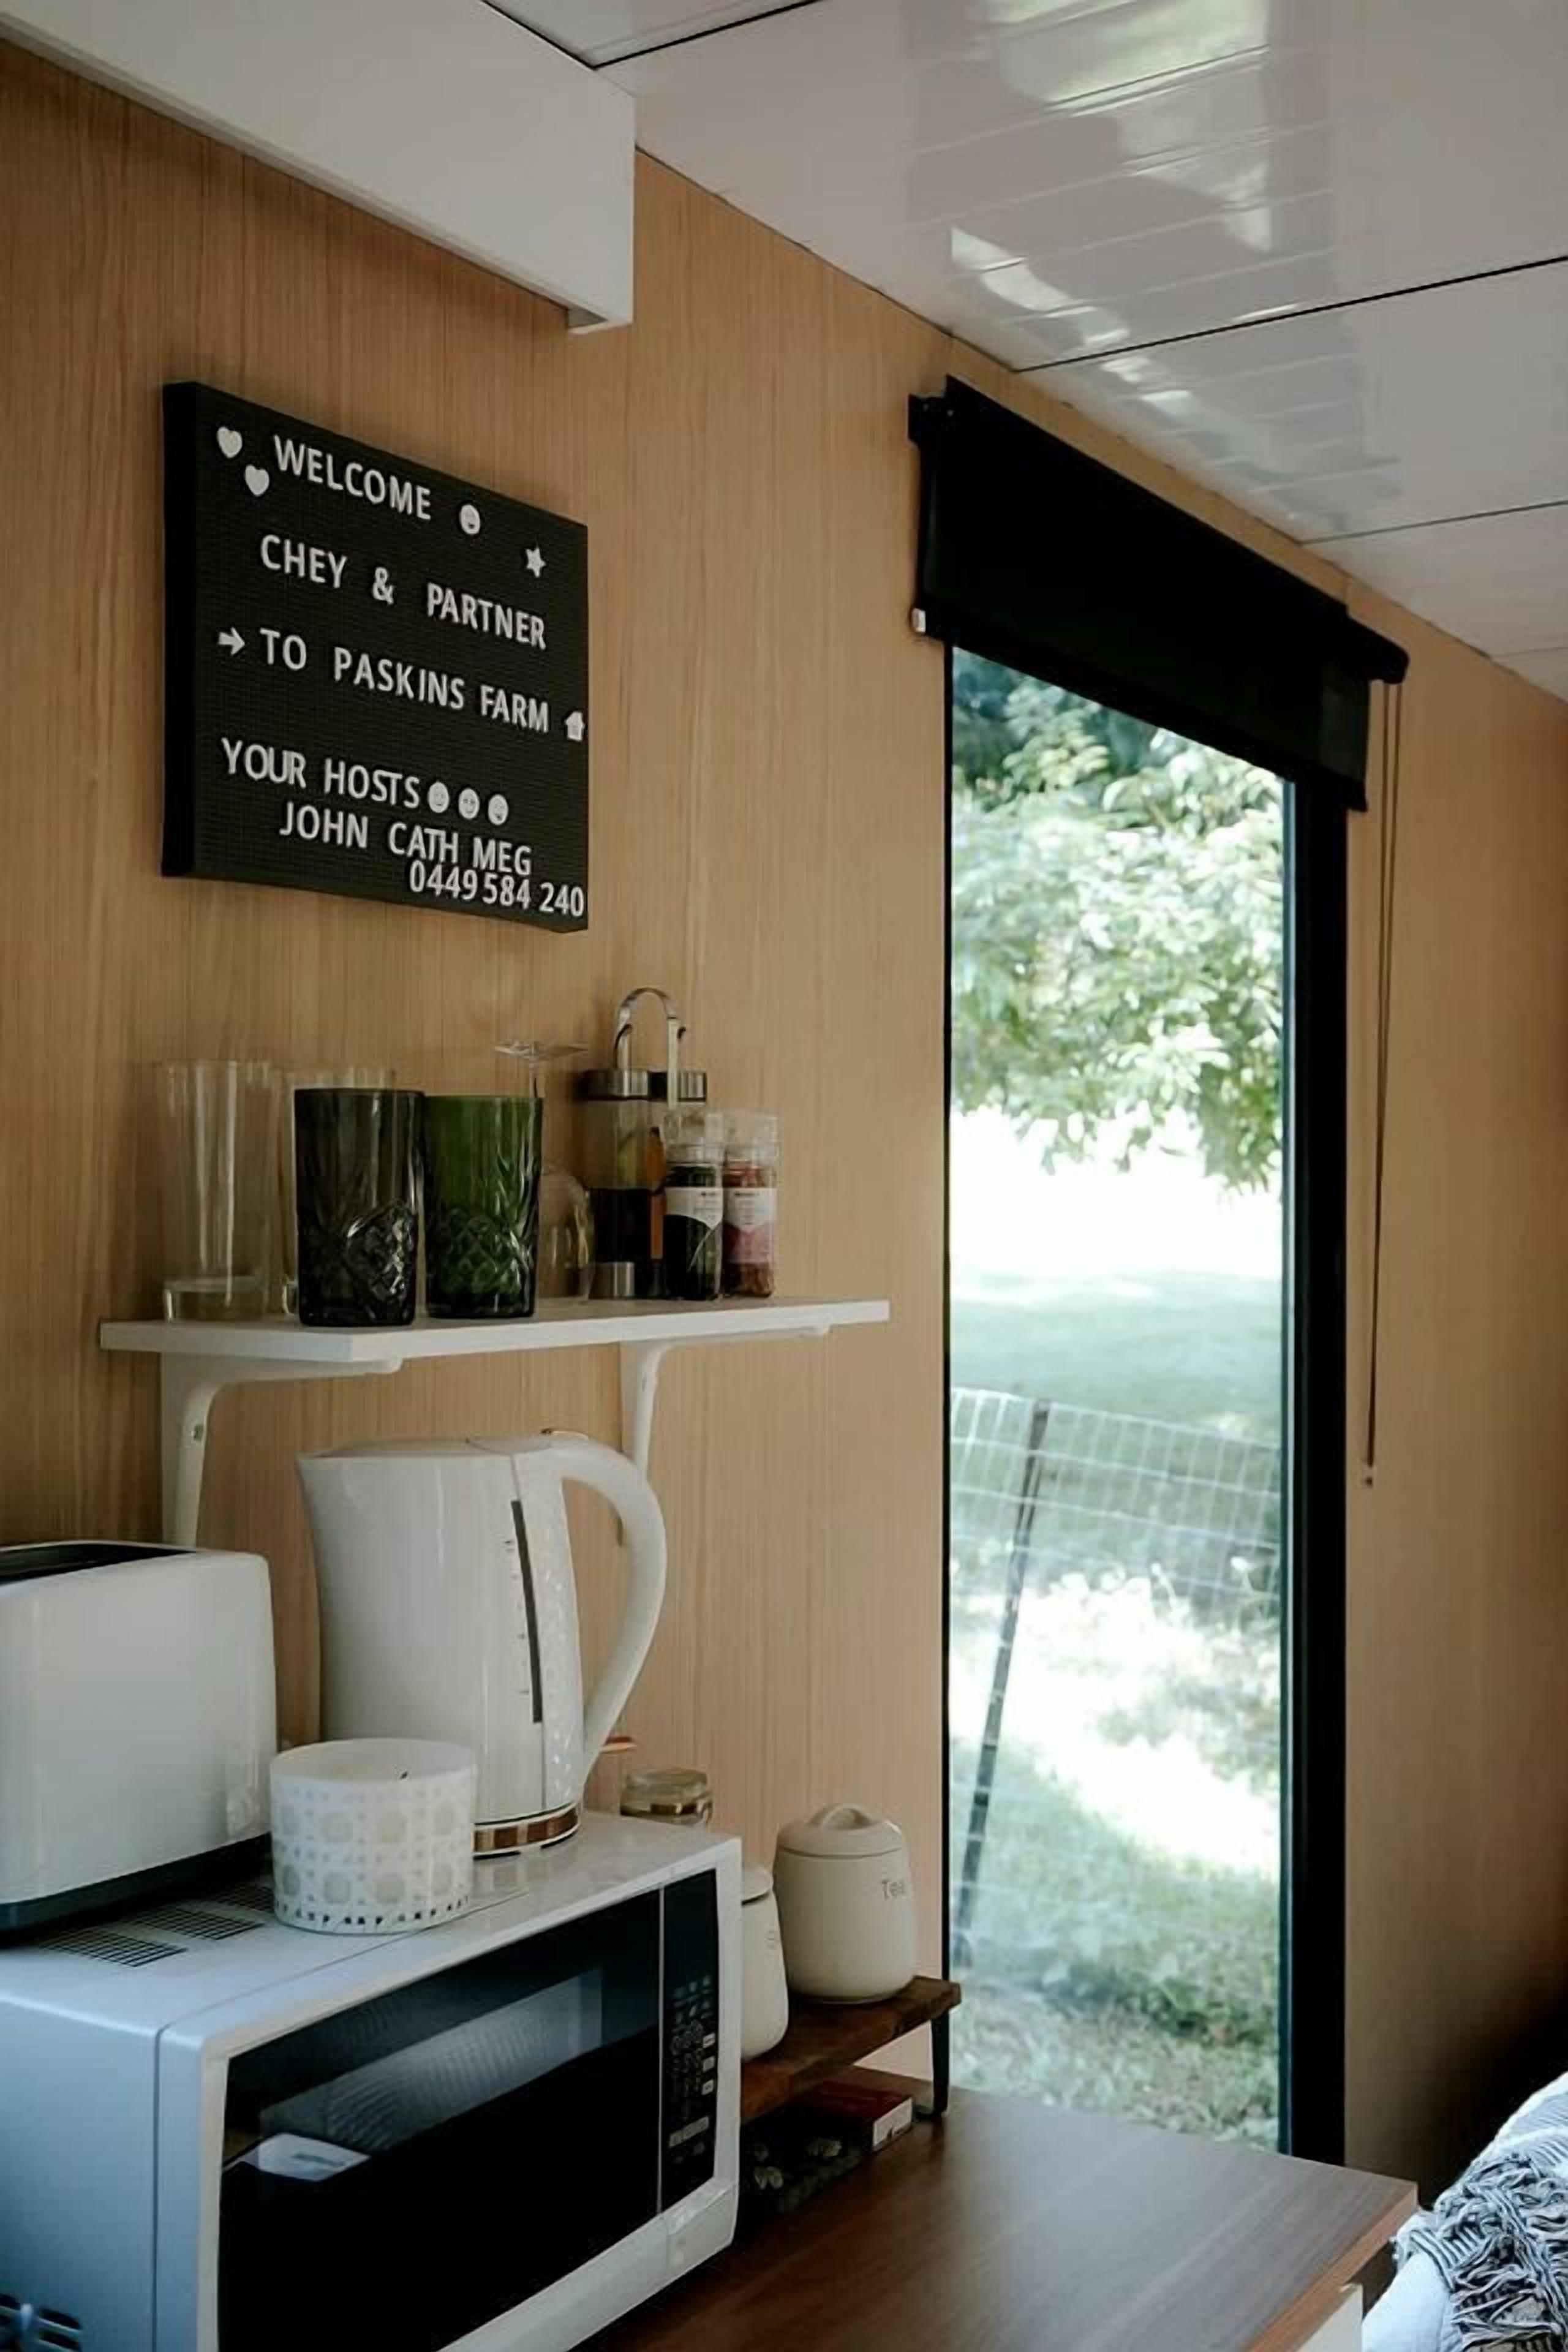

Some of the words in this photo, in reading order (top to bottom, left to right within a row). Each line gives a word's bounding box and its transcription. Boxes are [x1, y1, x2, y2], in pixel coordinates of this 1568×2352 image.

[274, 434, 431, 520] WELCOME
[261, 534, 347, 589] CHEY
[372, 567, 394, 605] &
[427, 582, 546, 650] PARTNER
[260, 627, 307, 671] TO
[334, 646, 465, 710] PASKINS
[480, 684, 549, 733] FARM
[221, 737, 307, 789] YOUR
[324, 758, 420, 809] HOSTS
[279, 801, 369, 849] JOHN
[388, 821, 459, 864] CATH
[472, 836, 532, 877] MEG
[409, 859, 478, 902] 0449
[482, 872, 532, 911] 584
[538, 881, 585, 918] 240
